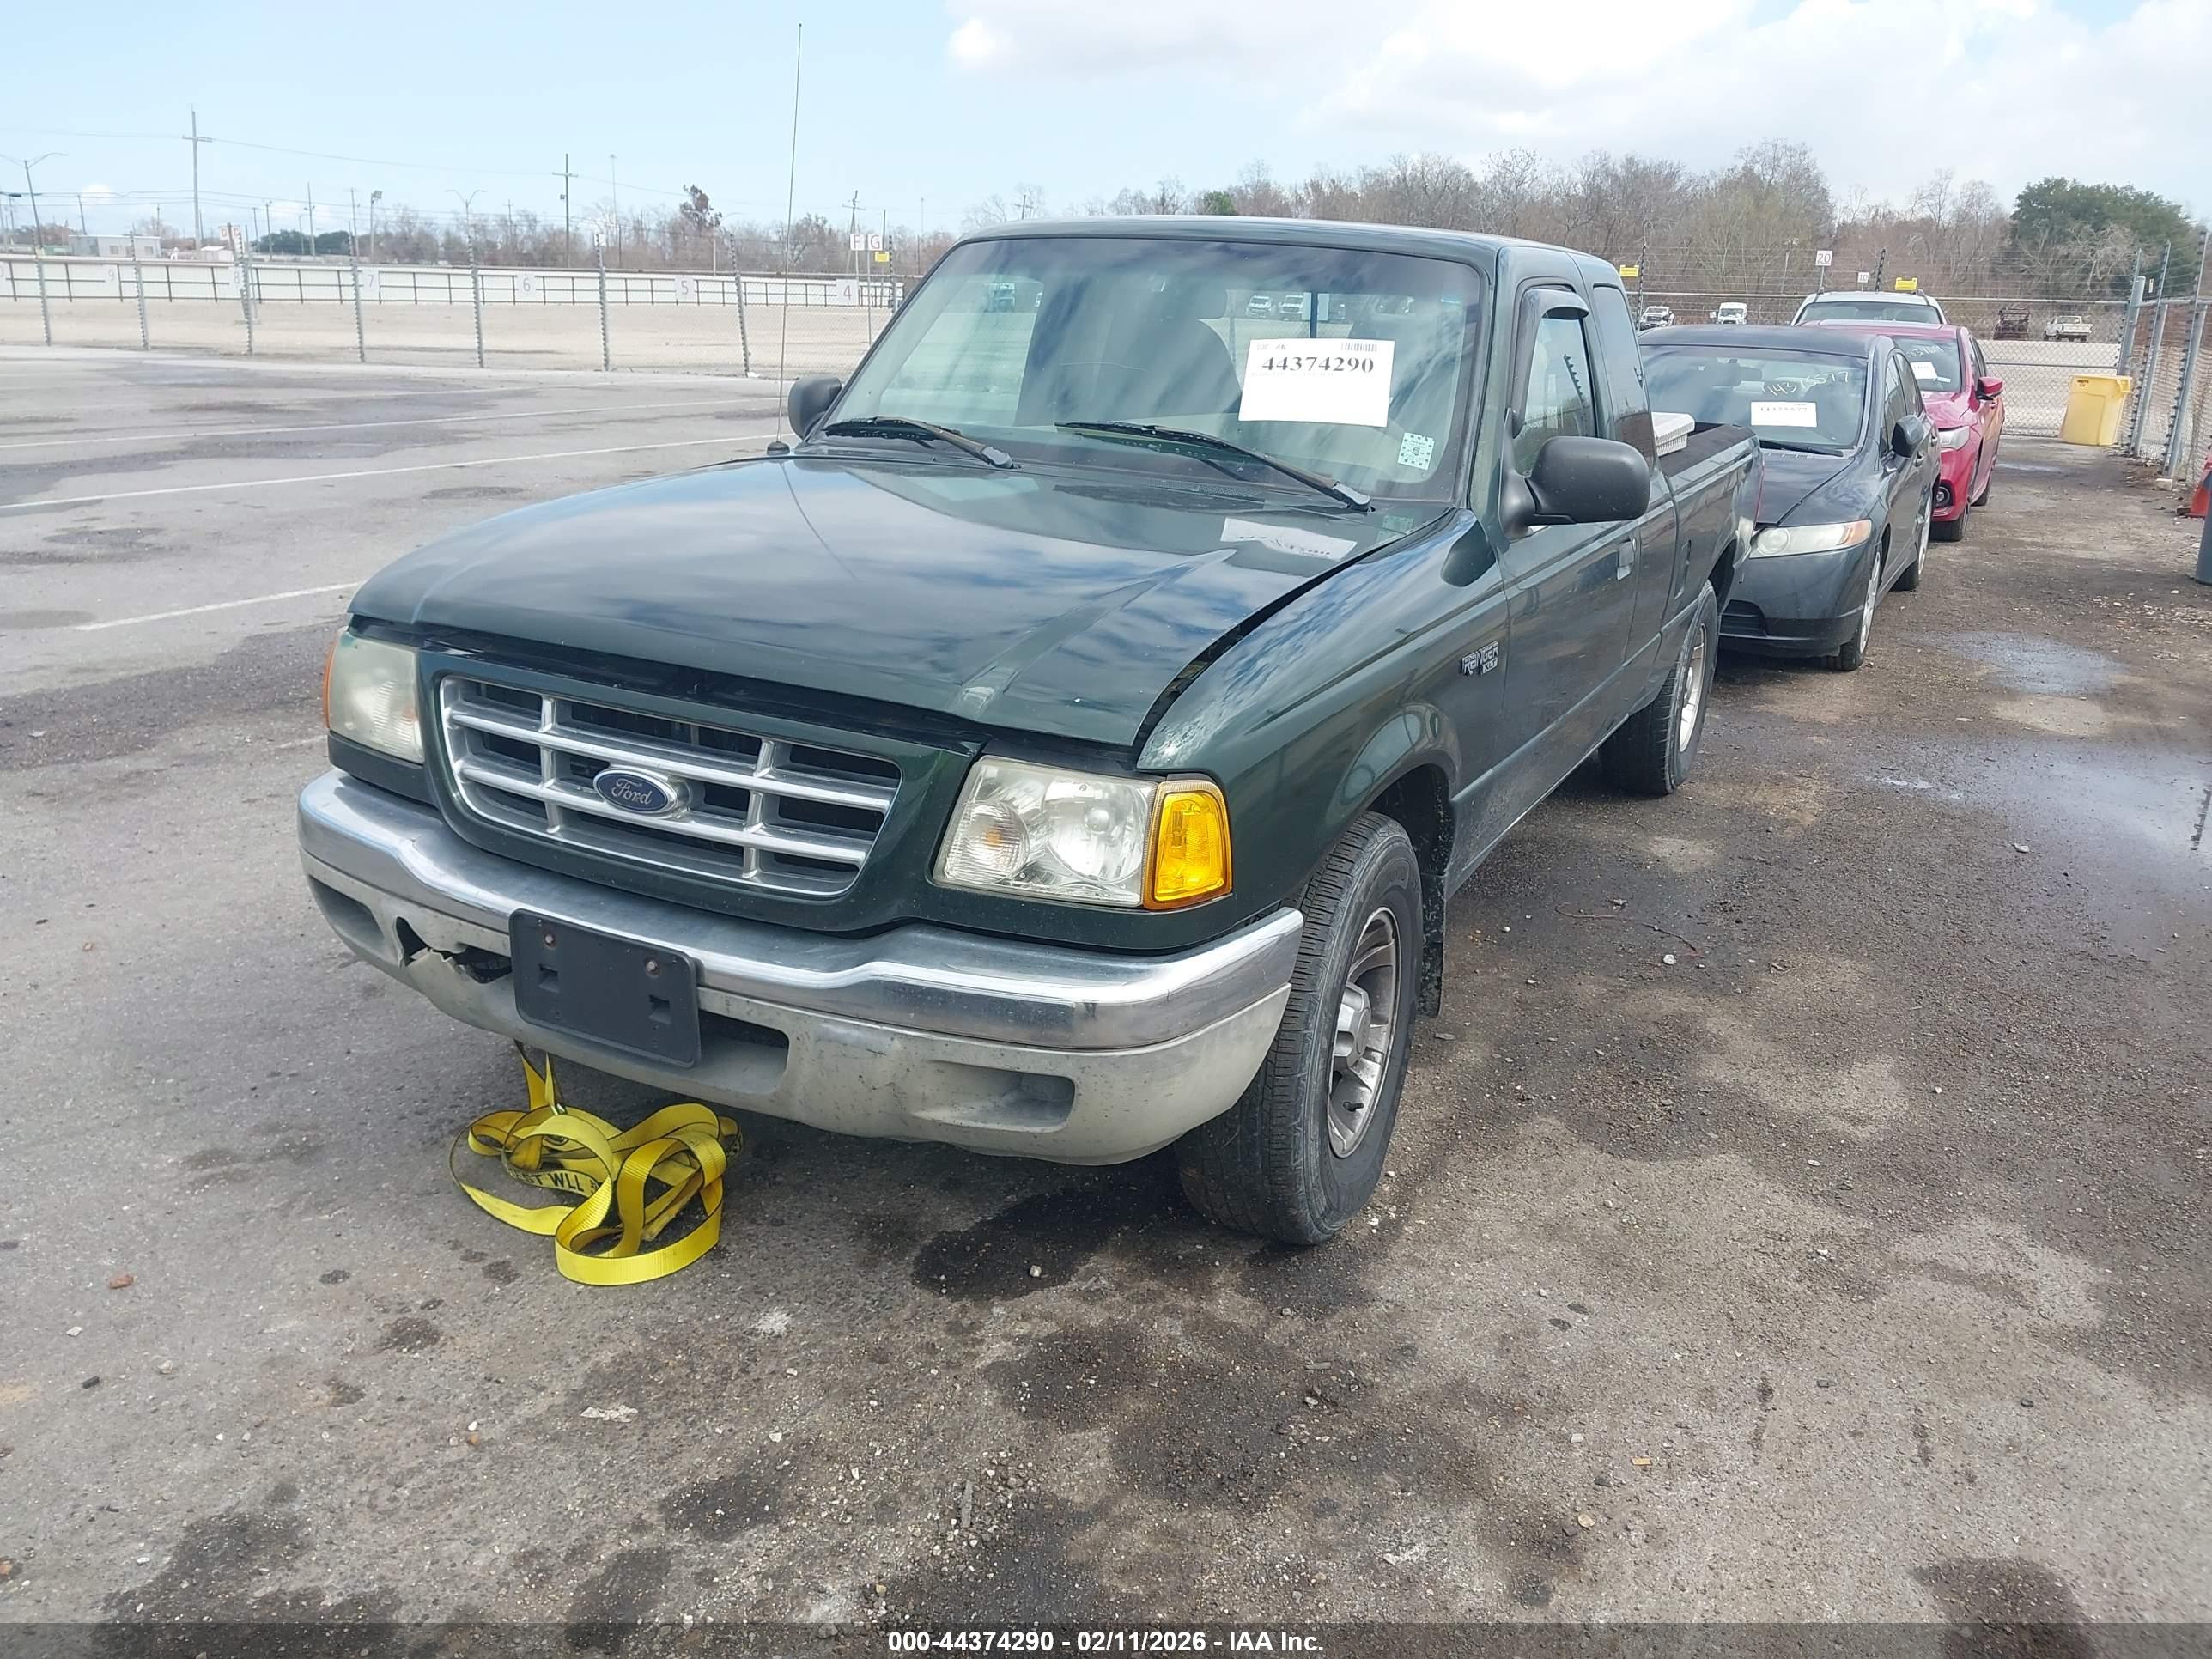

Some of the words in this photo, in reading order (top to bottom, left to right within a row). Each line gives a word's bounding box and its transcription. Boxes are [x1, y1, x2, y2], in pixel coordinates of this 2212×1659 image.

[853, 234, 860, 249] F
[870, 234, 880, 250] G
[1817, 253, 1832, 264] 20
[368, 274, 374, 288] 7
[522, 277, 532, 293] 6
[680, 279, 690, 295] 5
[843, 284, 853, 301] 4
[1261, 356, 1375, 373] 44374290
[611, 778, 653, 805] Ford
[547, 1172, 585, 1193] WLL
